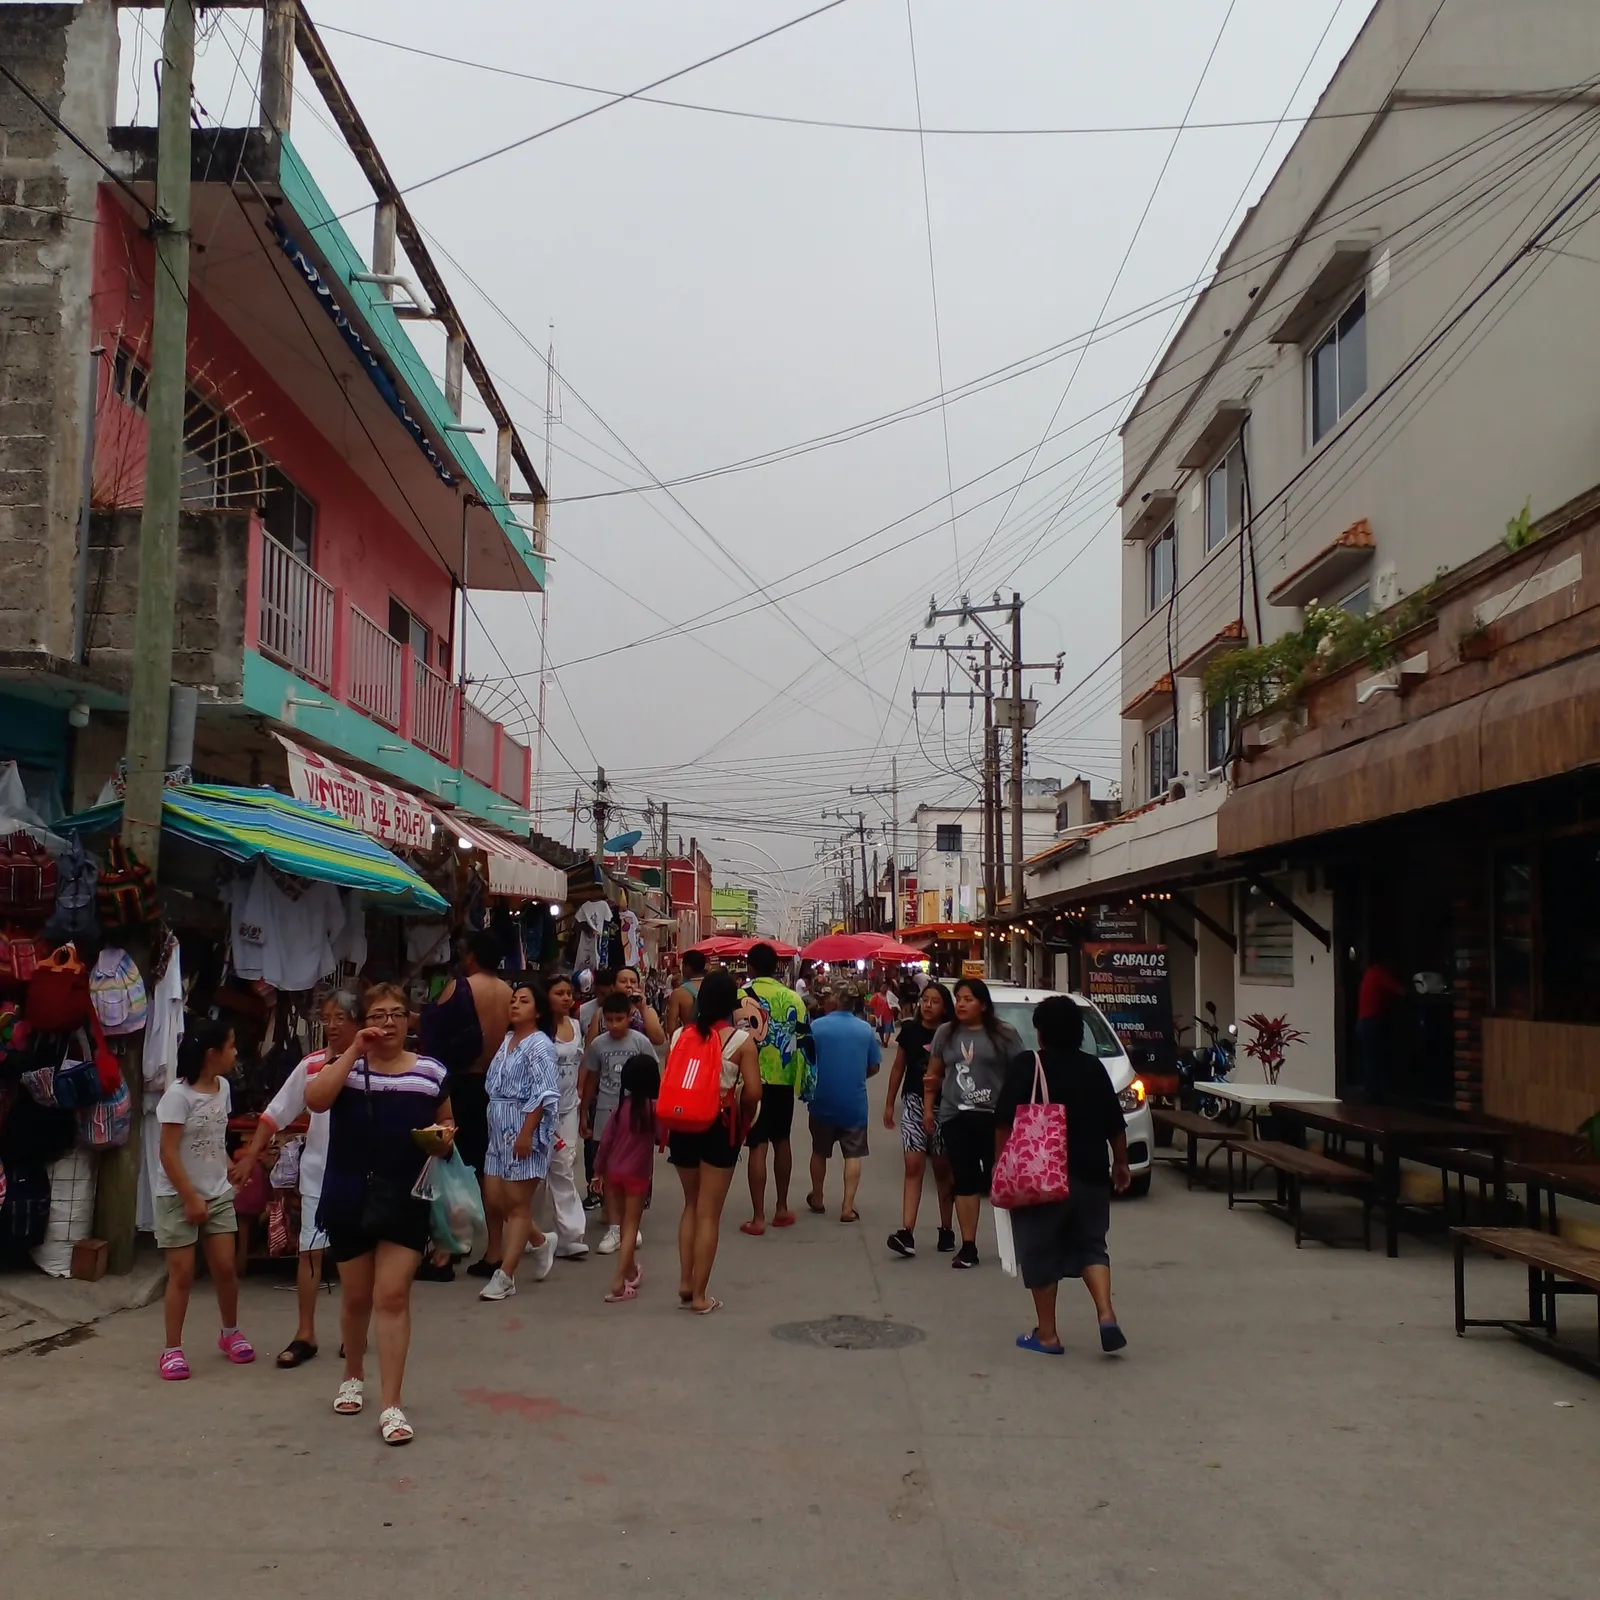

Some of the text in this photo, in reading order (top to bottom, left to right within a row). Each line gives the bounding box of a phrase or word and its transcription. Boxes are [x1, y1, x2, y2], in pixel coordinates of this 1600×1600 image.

[371, 797, 391, 827] DEL
[394, 805, 425, 837] GOLFO
[1112, 953, 1165, 967] SABALOS
[1089, 972, 1113, 983] TACOS
[1156, 968, 1168, 976] Bar
[1090, 993, 1158, 1005] HAMBURGUESAS
